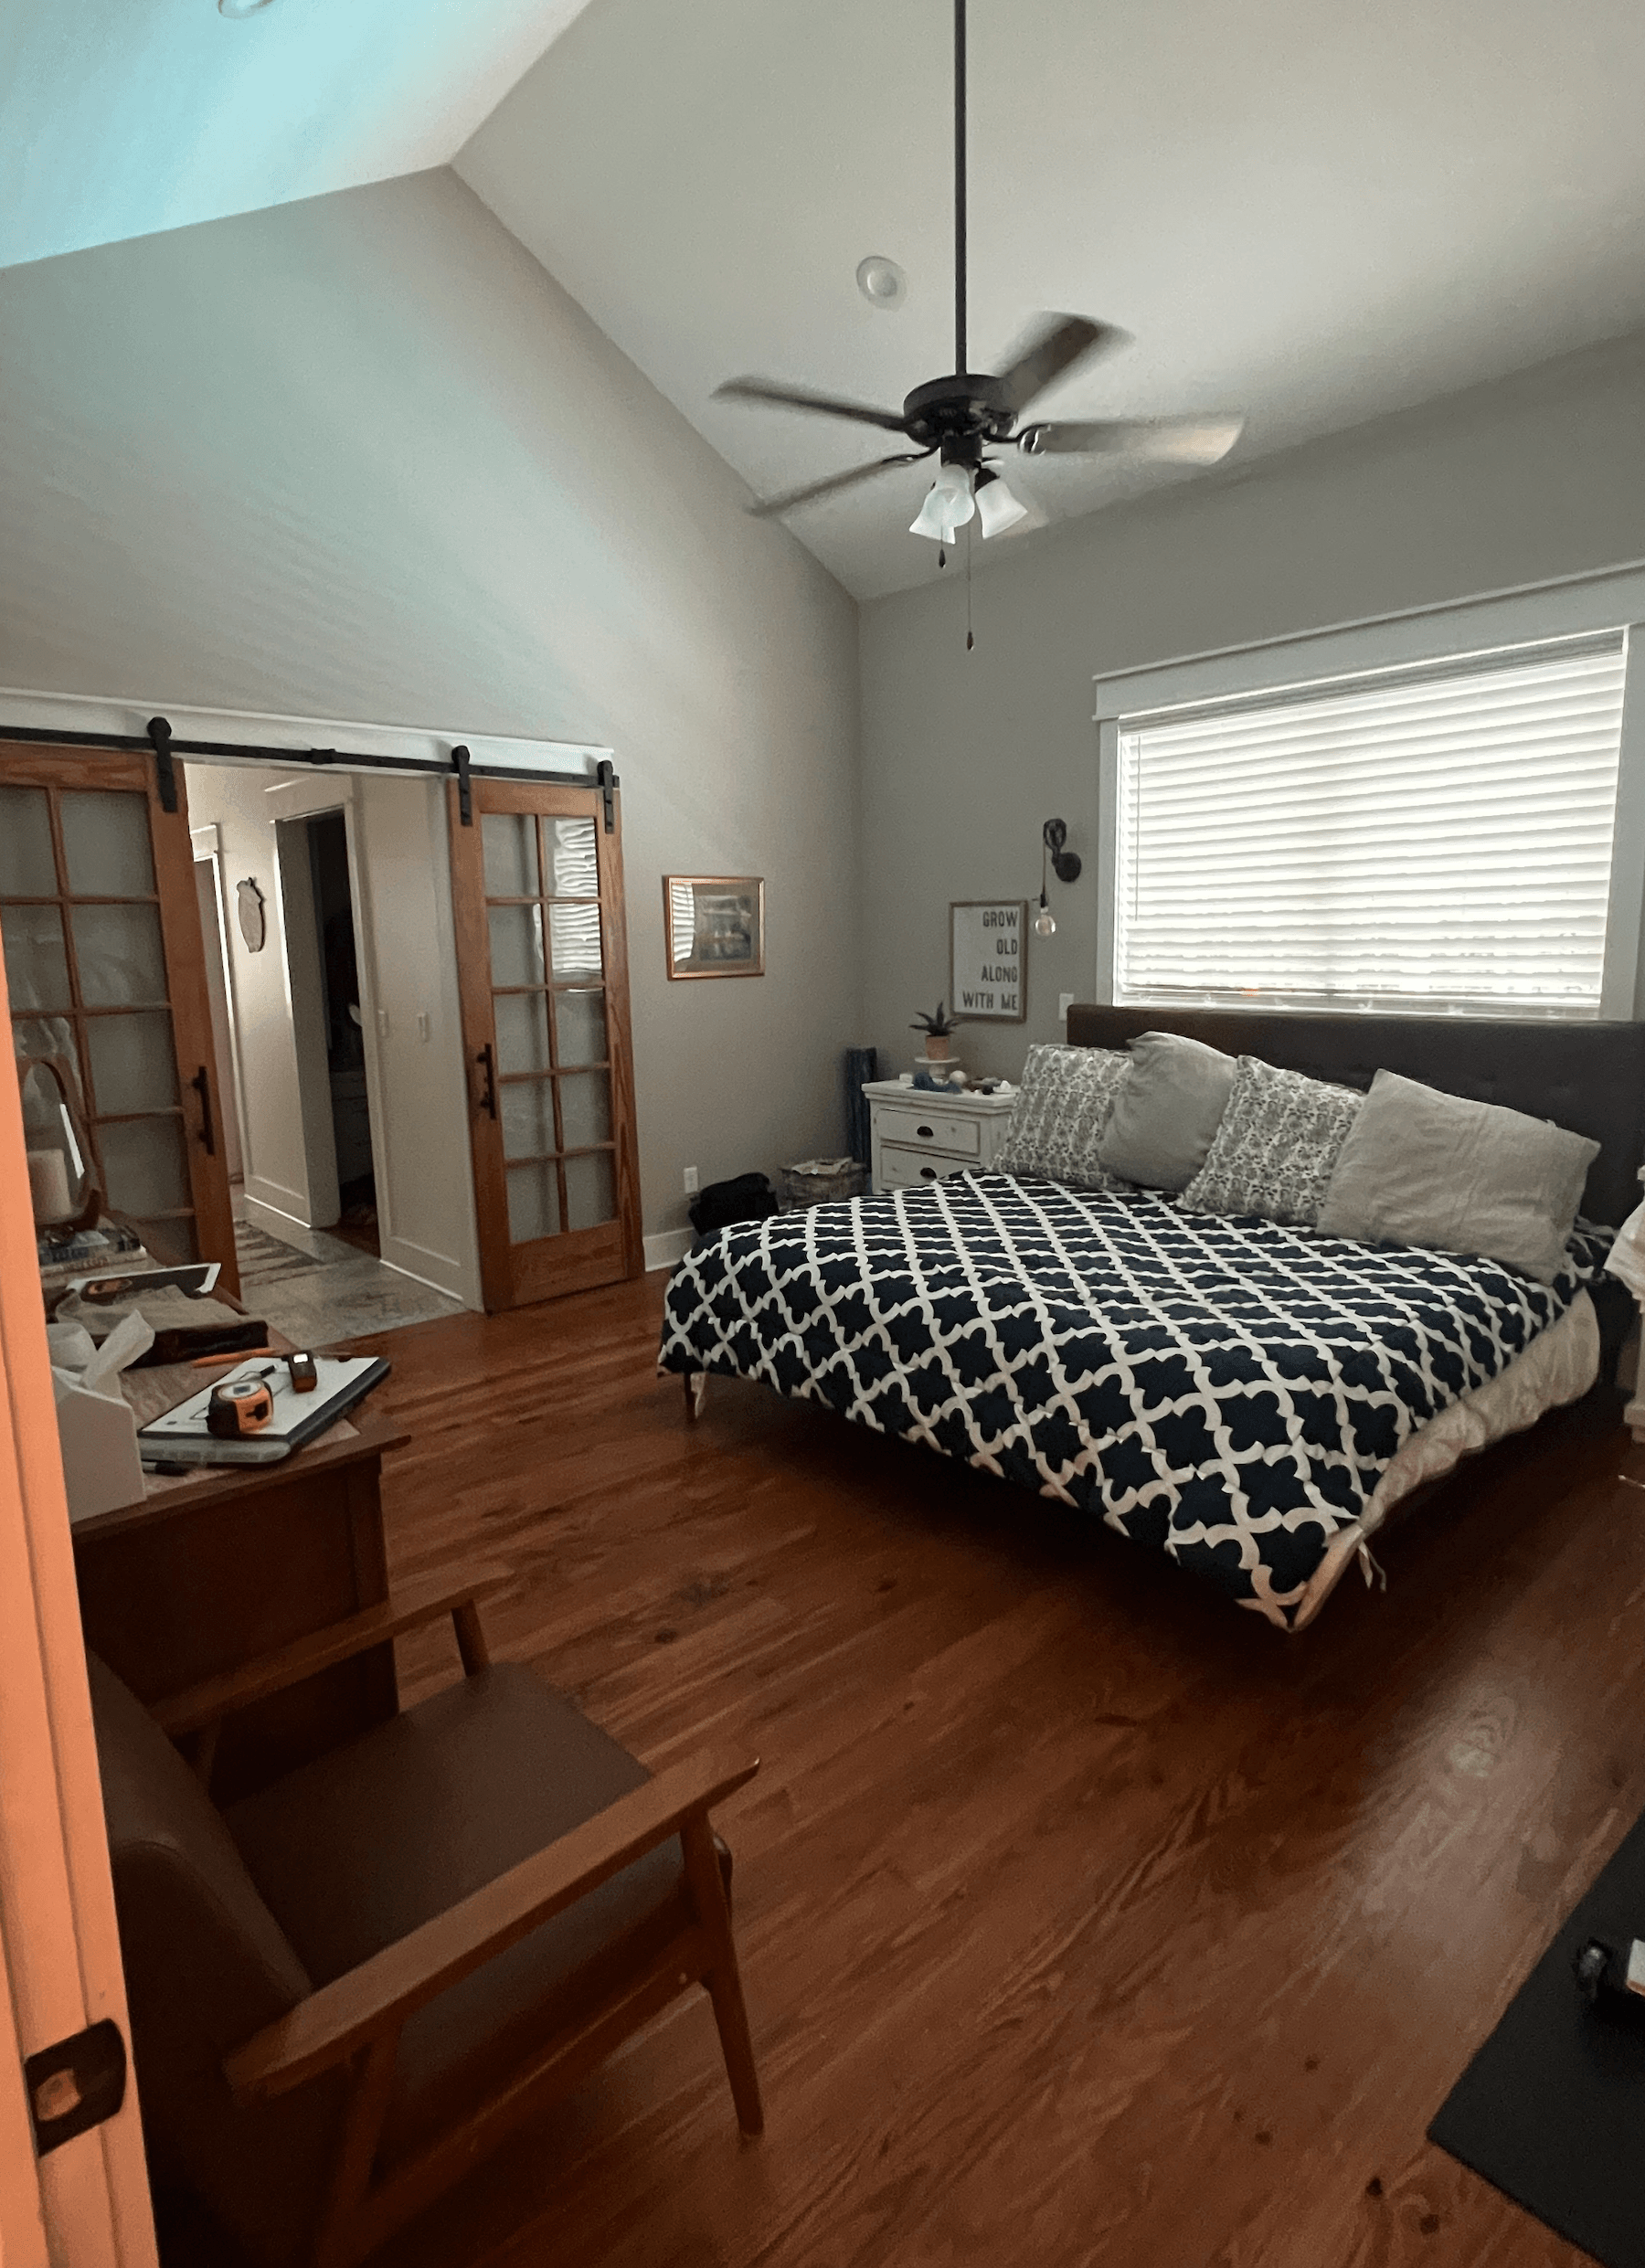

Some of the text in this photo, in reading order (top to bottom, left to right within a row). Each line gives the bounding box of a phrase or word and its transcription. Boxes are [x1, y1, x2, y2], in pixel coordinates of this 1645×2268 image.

[982, 911, 1017, 927] GROW
[996, 938, 1017, 955] OLD
[981, 965, 1017, 982] ALONG
[962, 991, 1017, 1010] WITH ME
